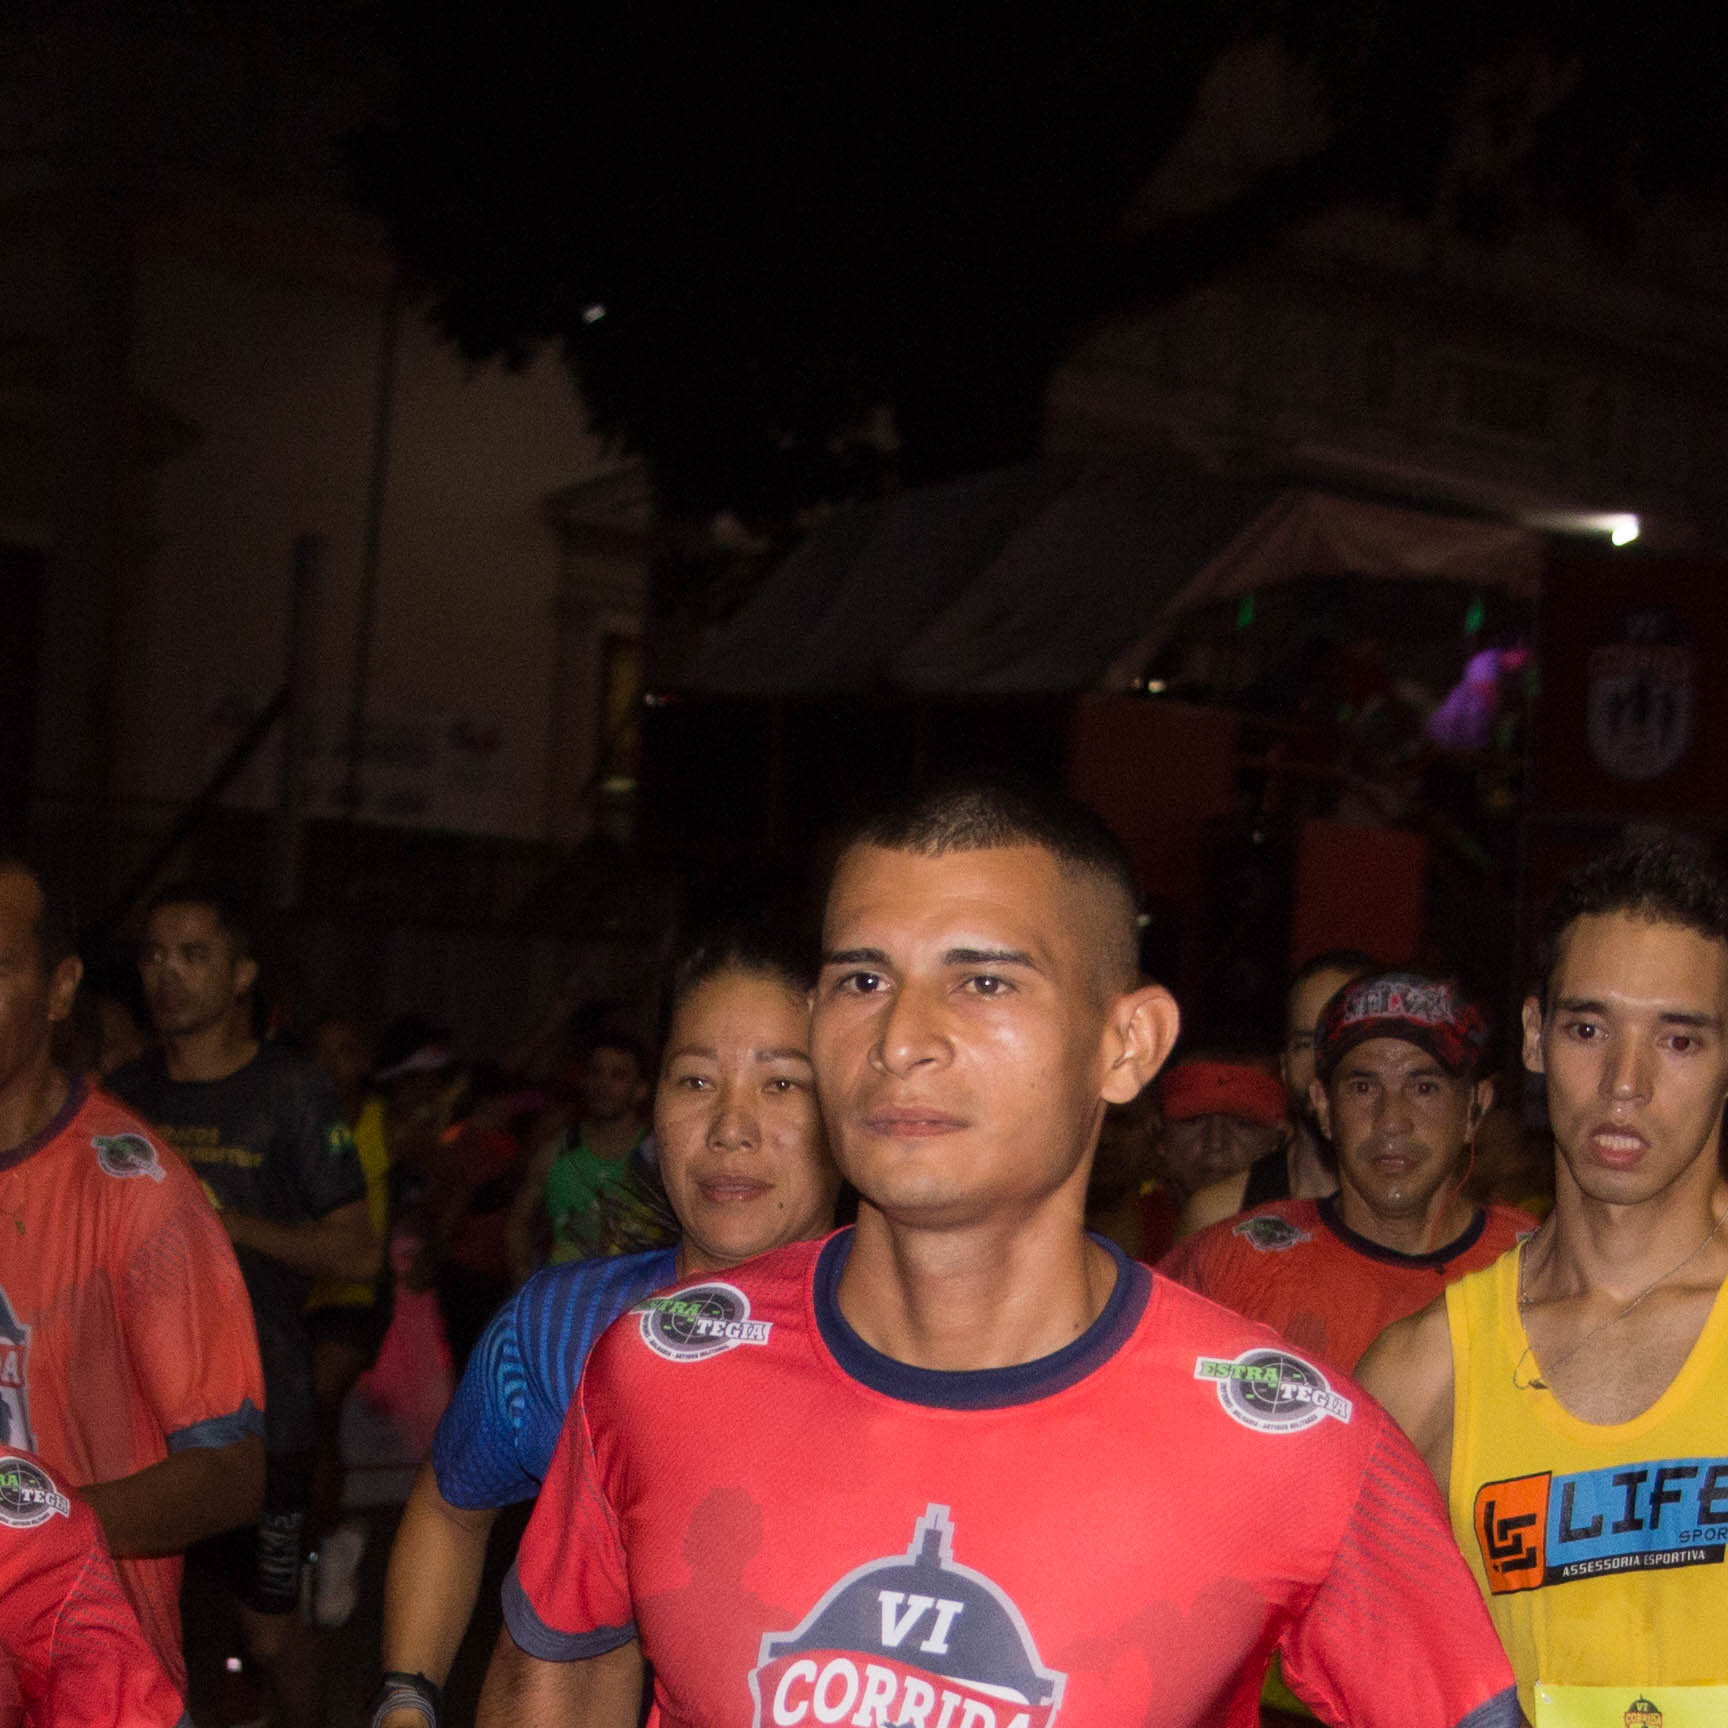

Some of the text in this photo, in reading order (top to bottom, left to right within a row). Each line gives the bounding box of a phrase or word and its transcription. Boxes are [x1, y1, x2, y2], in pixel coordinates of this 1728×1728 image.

[1201, 1360, 1279, 1384] ESTRA
[1562, 1547, 1707, 1578] ASSESSORIA ESPORTIVA
[876, 1588, 965, 1656] VI
